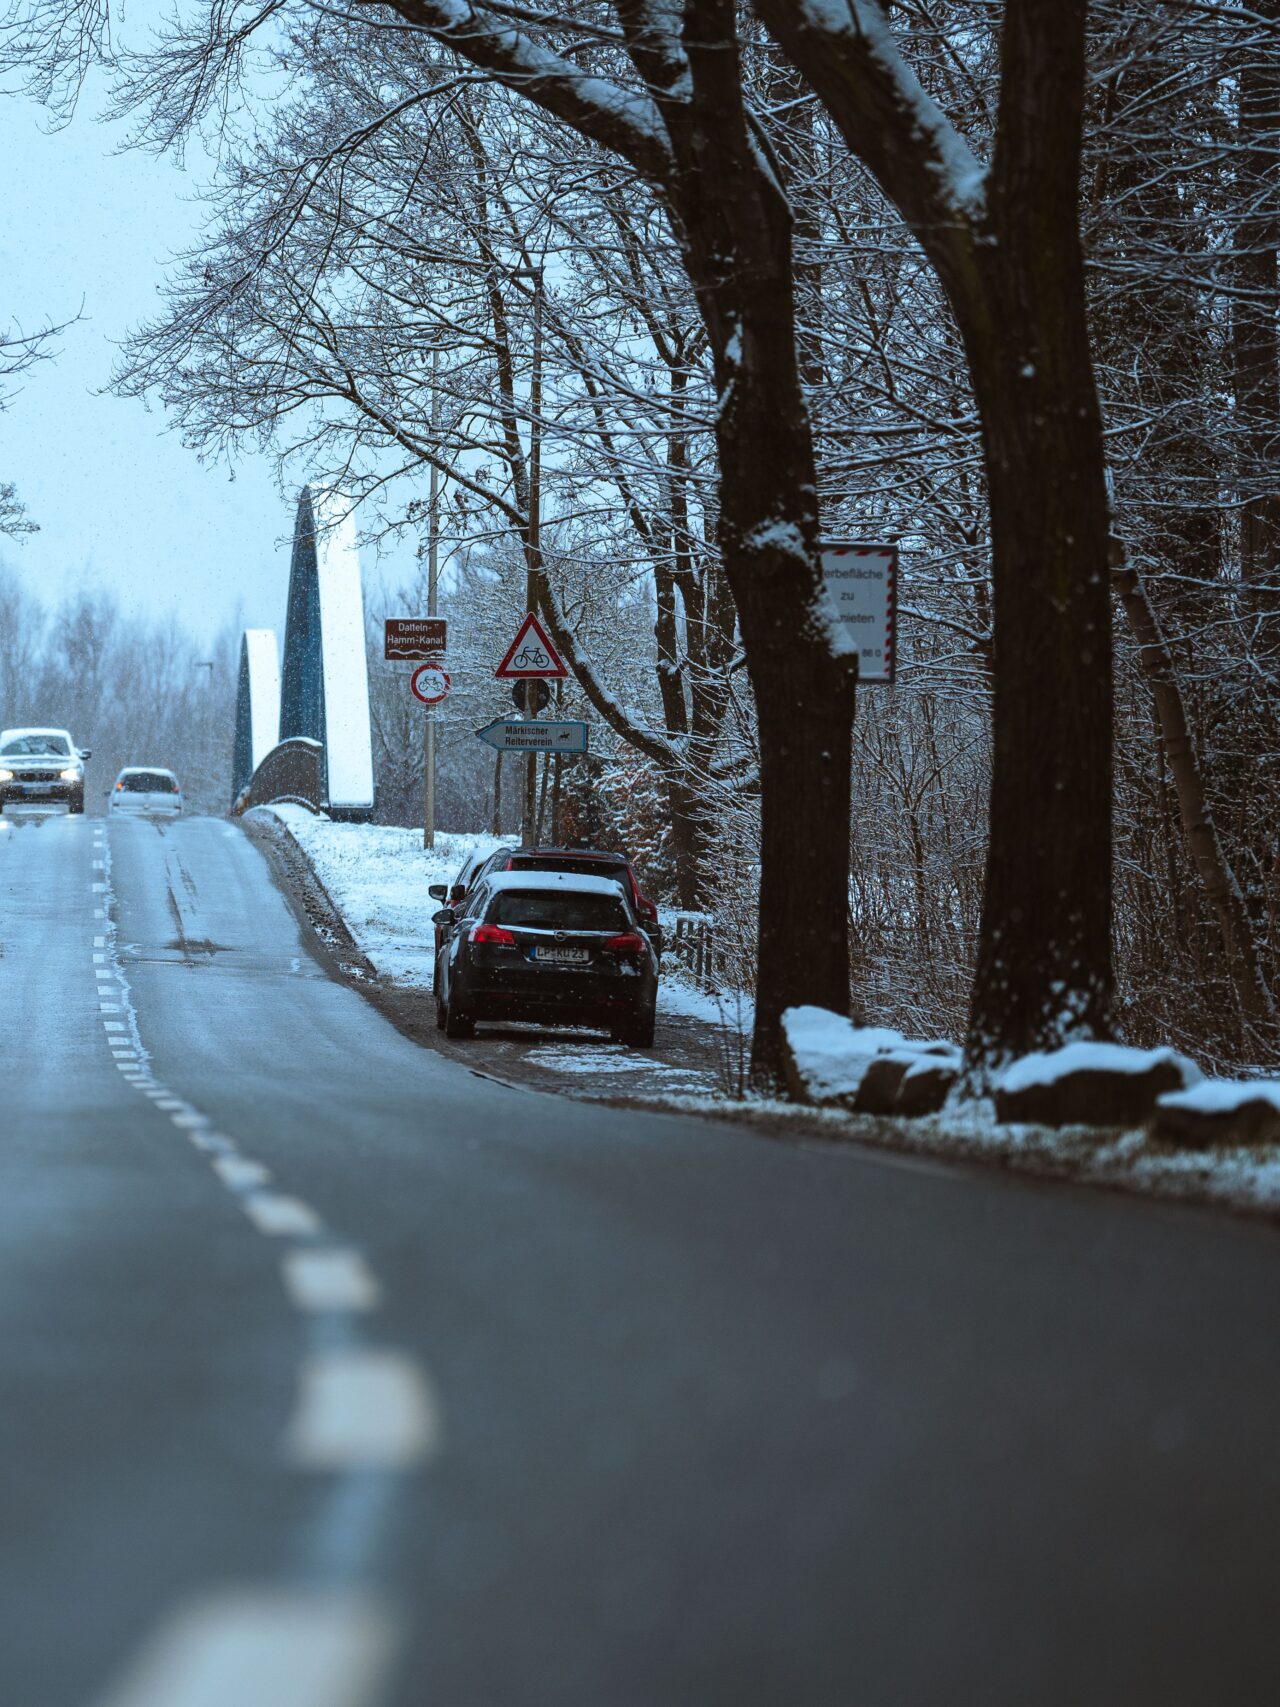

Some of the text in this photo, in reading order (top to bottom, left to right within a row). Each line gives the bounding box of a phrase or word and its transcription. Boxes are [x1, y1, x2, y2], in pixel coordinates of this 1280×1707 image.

[841, 593, 854, 601] zu
[399, 623, 432, 632] Datteln-
[387, 635, 444, 645] Hamm-Kanal
[505, 736, 553, 746] Reiterverein
